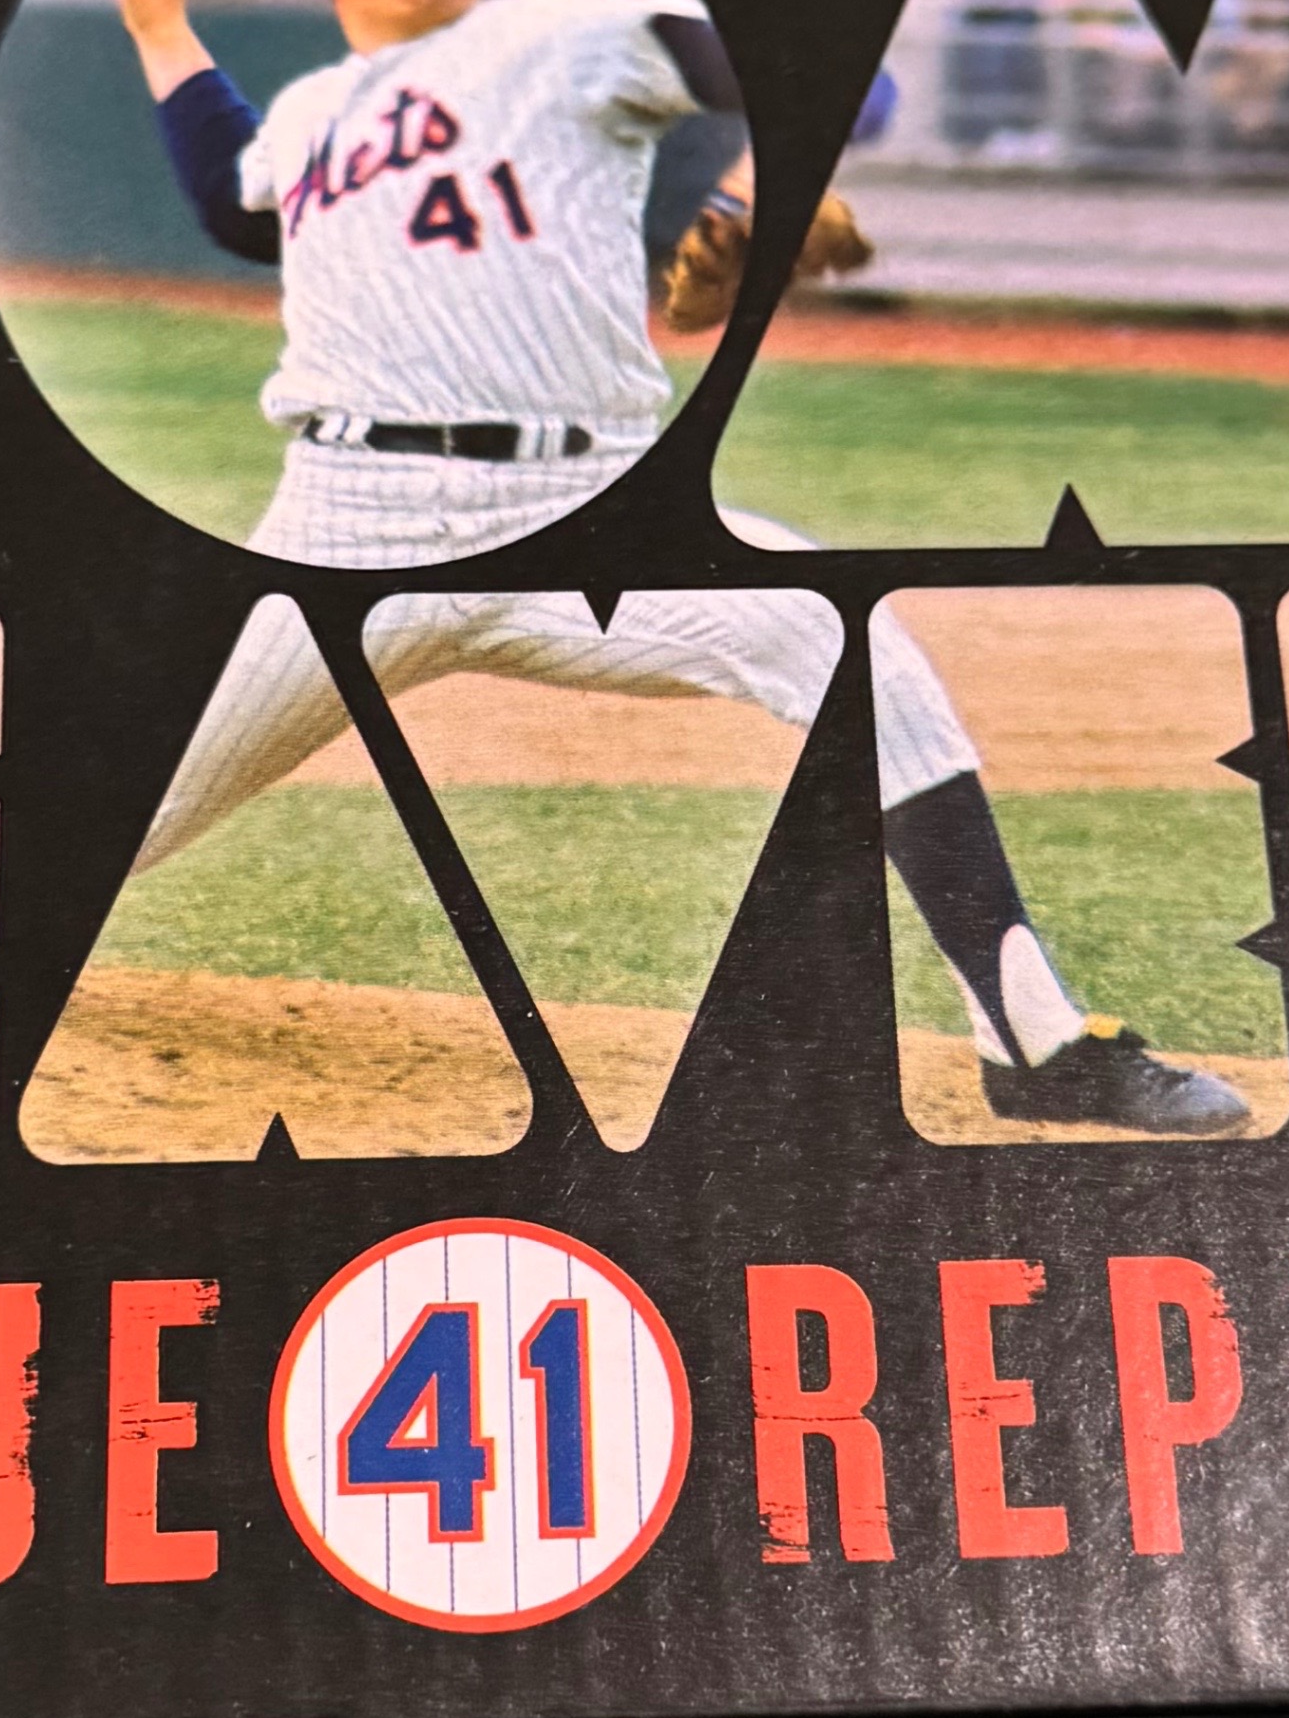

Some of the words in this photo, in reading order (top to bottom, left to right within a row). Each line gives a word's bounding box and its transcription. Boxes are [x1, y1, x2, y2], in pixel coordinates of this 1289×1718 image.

[281, 87, 462, 239] Mets
[406, 160, 537, 253] 41
[337, 1298, 596, 1544] 41
